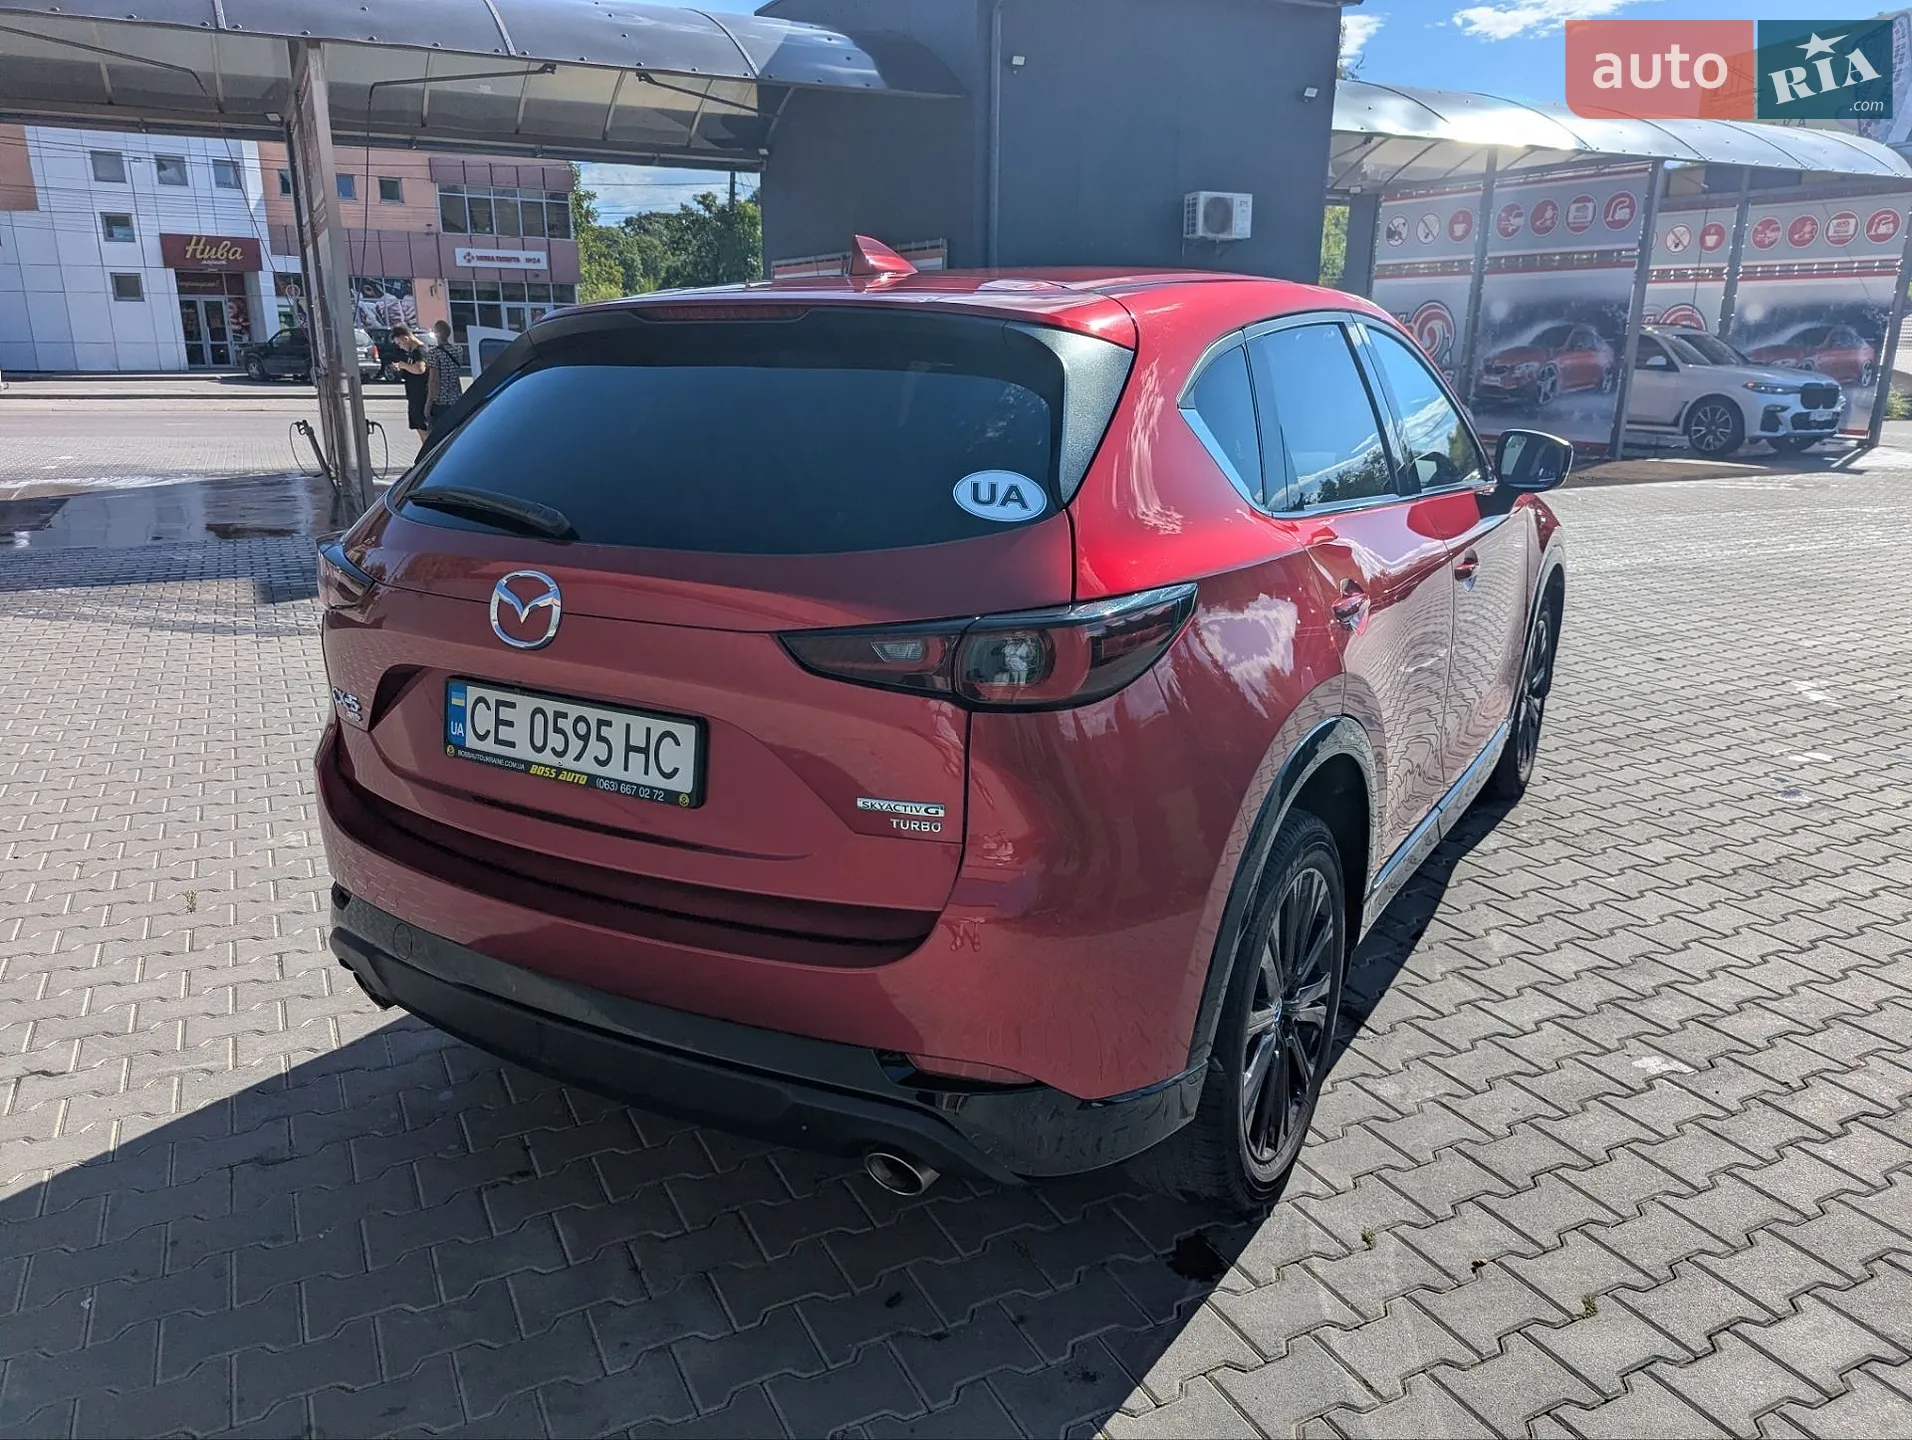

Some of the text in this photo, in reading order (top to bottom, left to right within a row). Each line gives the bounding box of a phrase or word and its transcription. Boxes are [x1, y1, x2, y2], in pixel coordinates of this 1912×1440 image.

[185, 236, 244, 260] Нива
[970, 481, 1032, 512] UA
[451, 721, 465, 737] UA
[470, 696, 682, 780] CE 0595 HC
[529, 764, 588, 785] BOSS AUTO
[595, 778, 665, 801] (063) 667 02 72
[890, 818, 942, 833] TURBO
